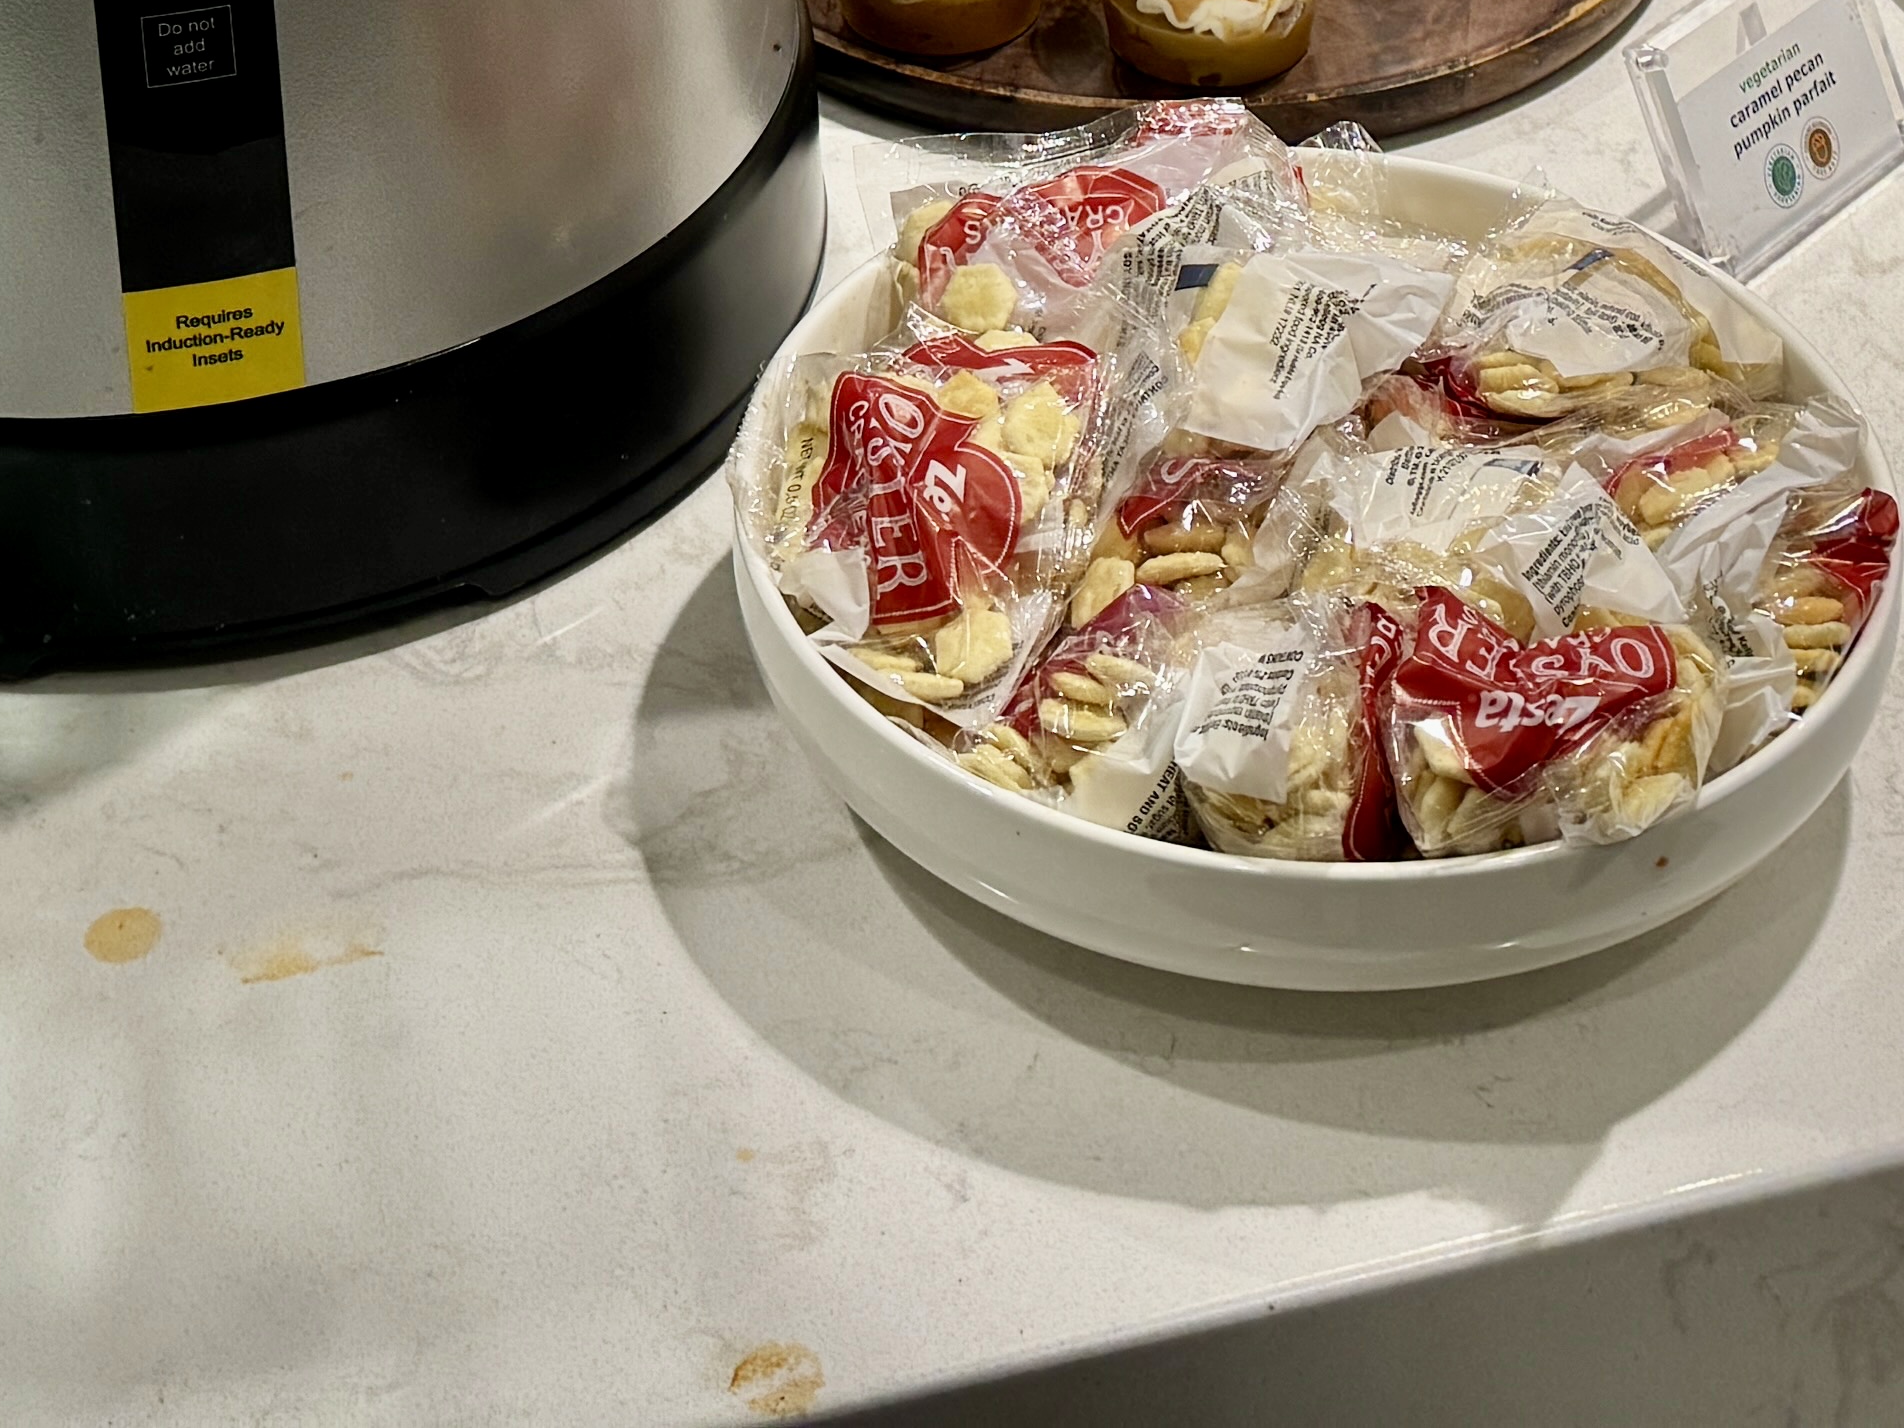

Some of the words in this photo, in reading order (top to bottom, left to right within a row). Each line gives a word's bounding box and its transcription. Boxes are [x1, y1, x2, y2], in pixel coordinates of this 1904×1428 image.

[158, 23, 183, 37] Do
[188, 17, 215, 32] not
[173, 37, 206, 56] add
[166, 60, 215, 76] water
[1739, 43, 1801, 94] vegetarian
[1730, 79, 1783, 128] caramel
[1785, 52, 1824, 93] pecan
[1734, 105, 1792, 161] pumpkin
[1792, 70, 1837, 117] parfait
[176, 307, 253, 329] Requires
[145, 320, 284, 353] Induction-Ready
[192, 348, 244, 367] Insets
[867, 393, 928, 600] OYSTER
[1156, 759, 1178, 792] HEAT
